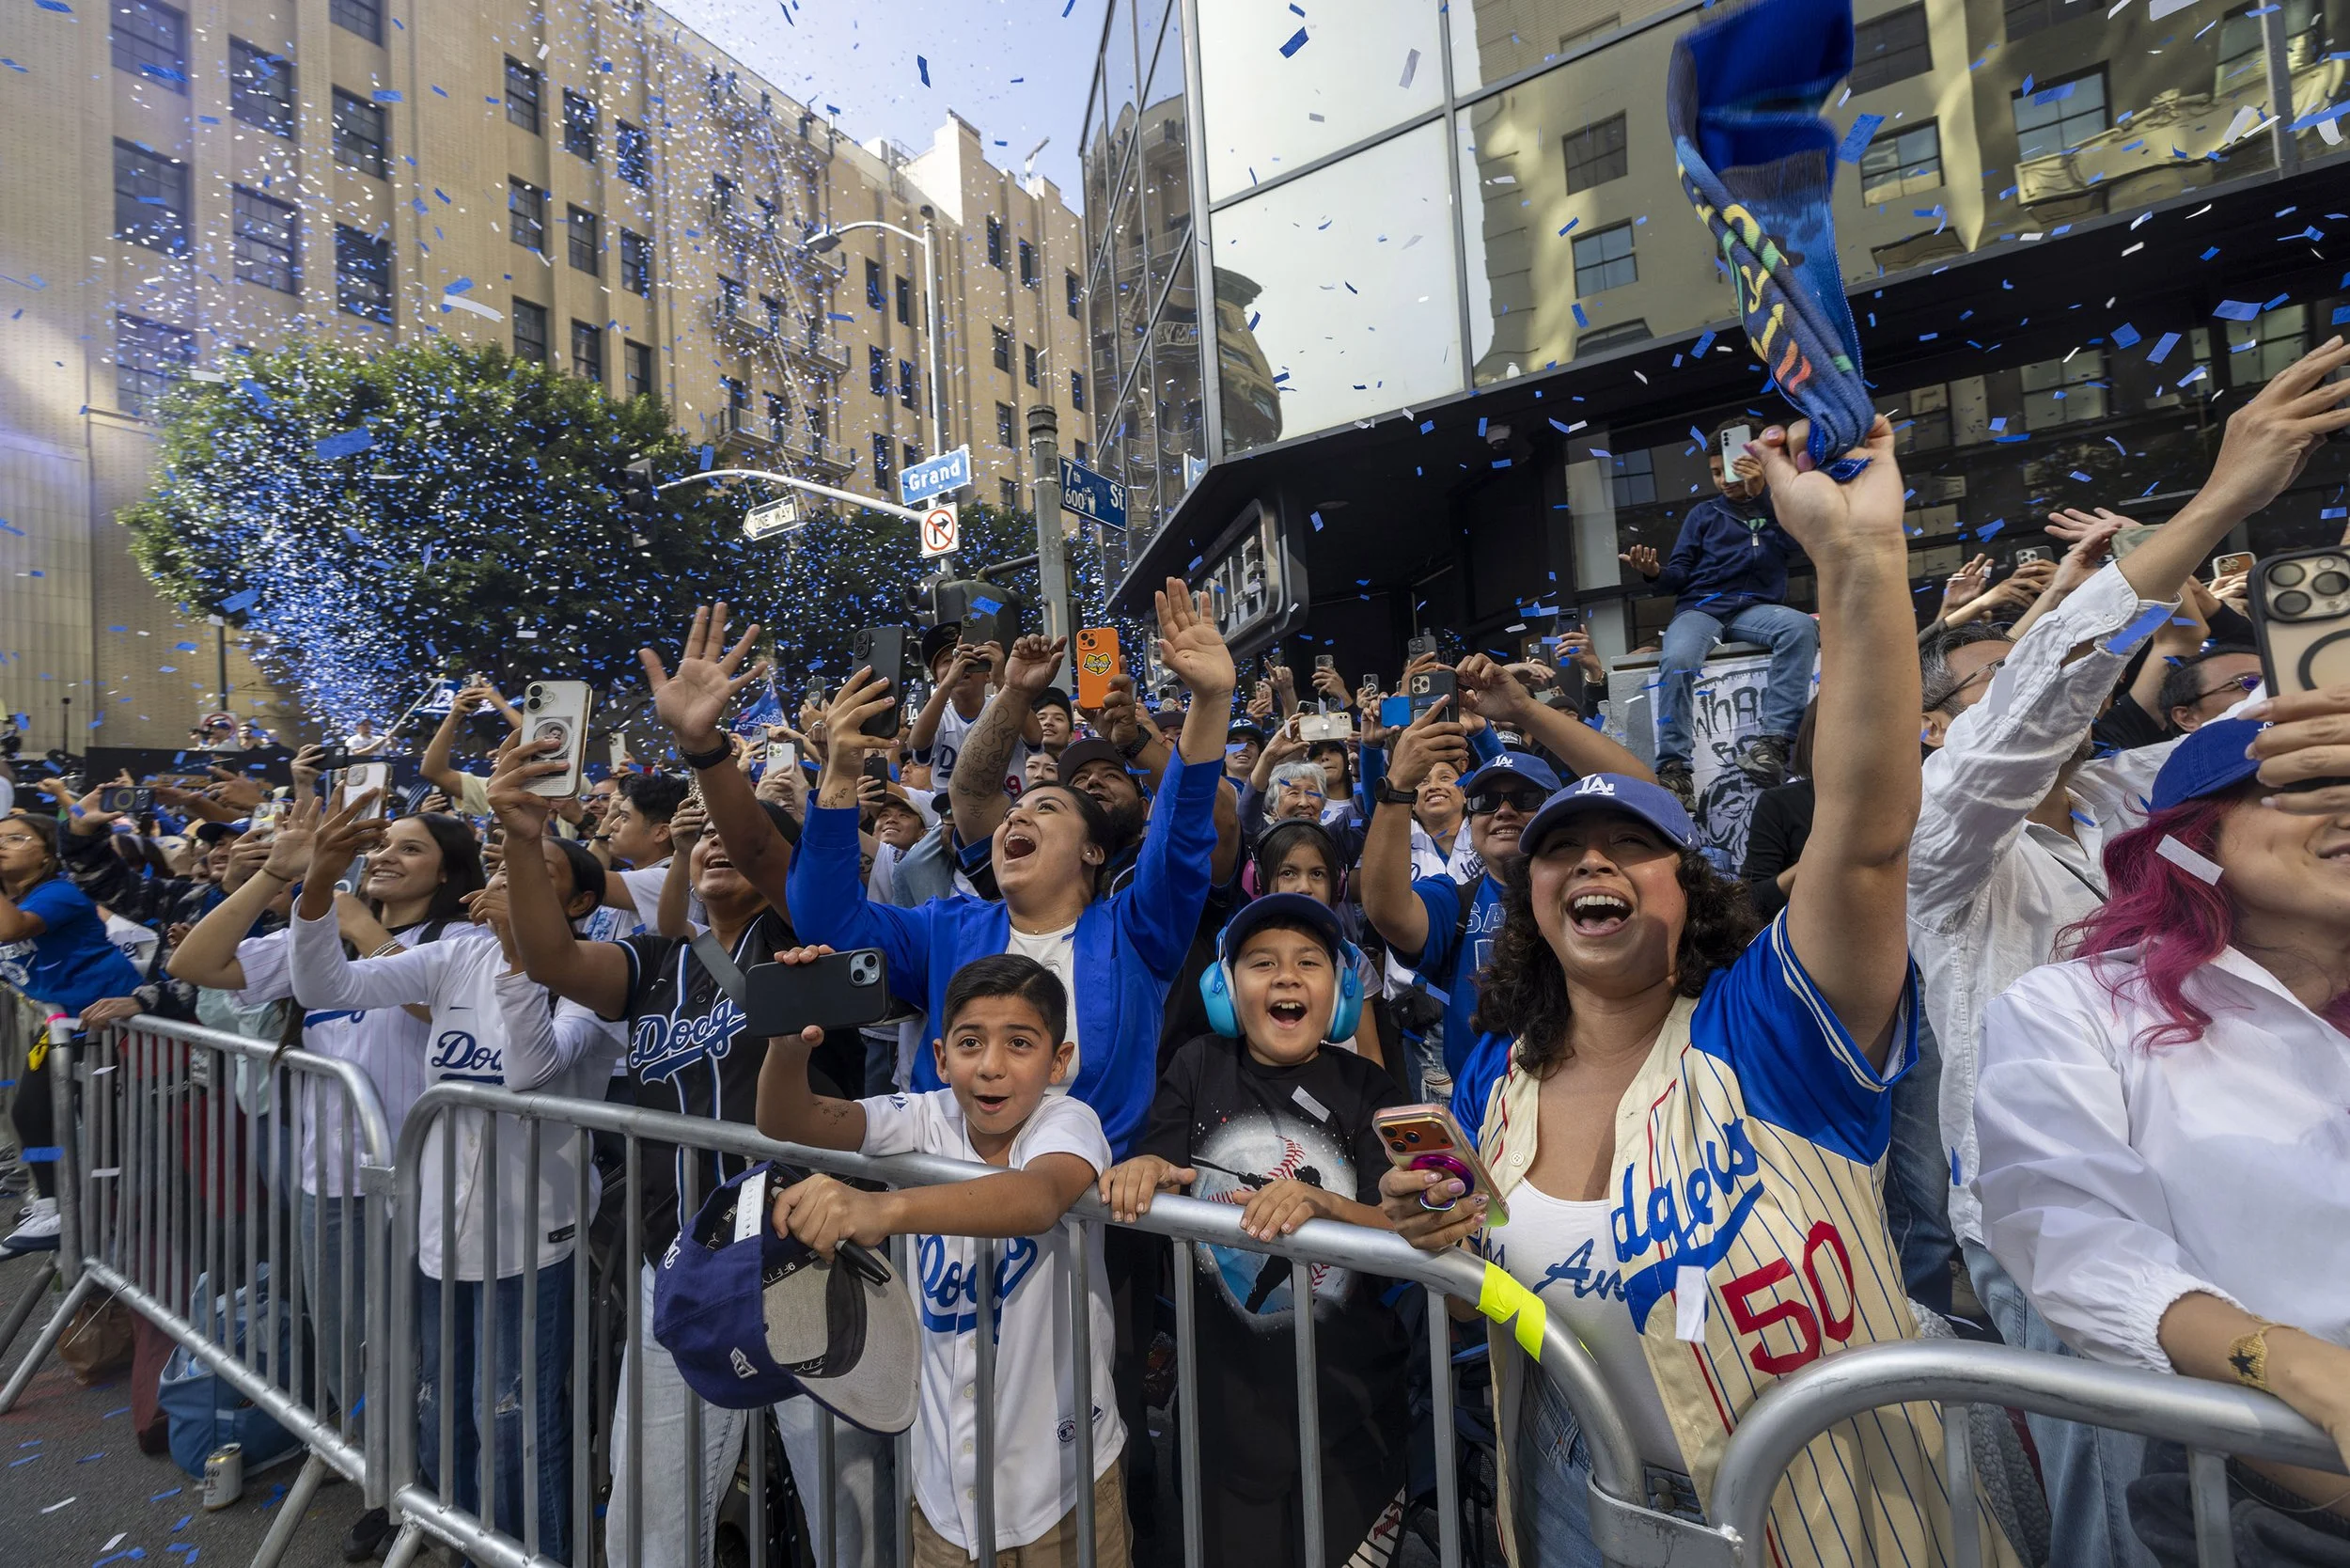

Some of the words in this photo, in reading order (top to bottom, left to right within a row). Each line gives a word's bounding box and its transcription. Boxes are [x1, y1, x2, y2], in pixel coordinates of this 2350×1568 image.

[908, 458, 961, 492] Grand
[1063, 461, 1081, 486] 7th
[1110, 483, 1124, 511] St
[1065, 487, 1084, 510] 600
[755, 513, 770, 529] ONE
[774, 505, 791, 524] WAY
[906, 703, 919, 726] LA
[1232, 718, 1253, 729] 42
[1492, 753, 1513, 768] LA
[1574, 774, 1616, 797] LA
[629, 987, 746, 1069] Dodg
[1719, 1219, 1855, 1375] 50
